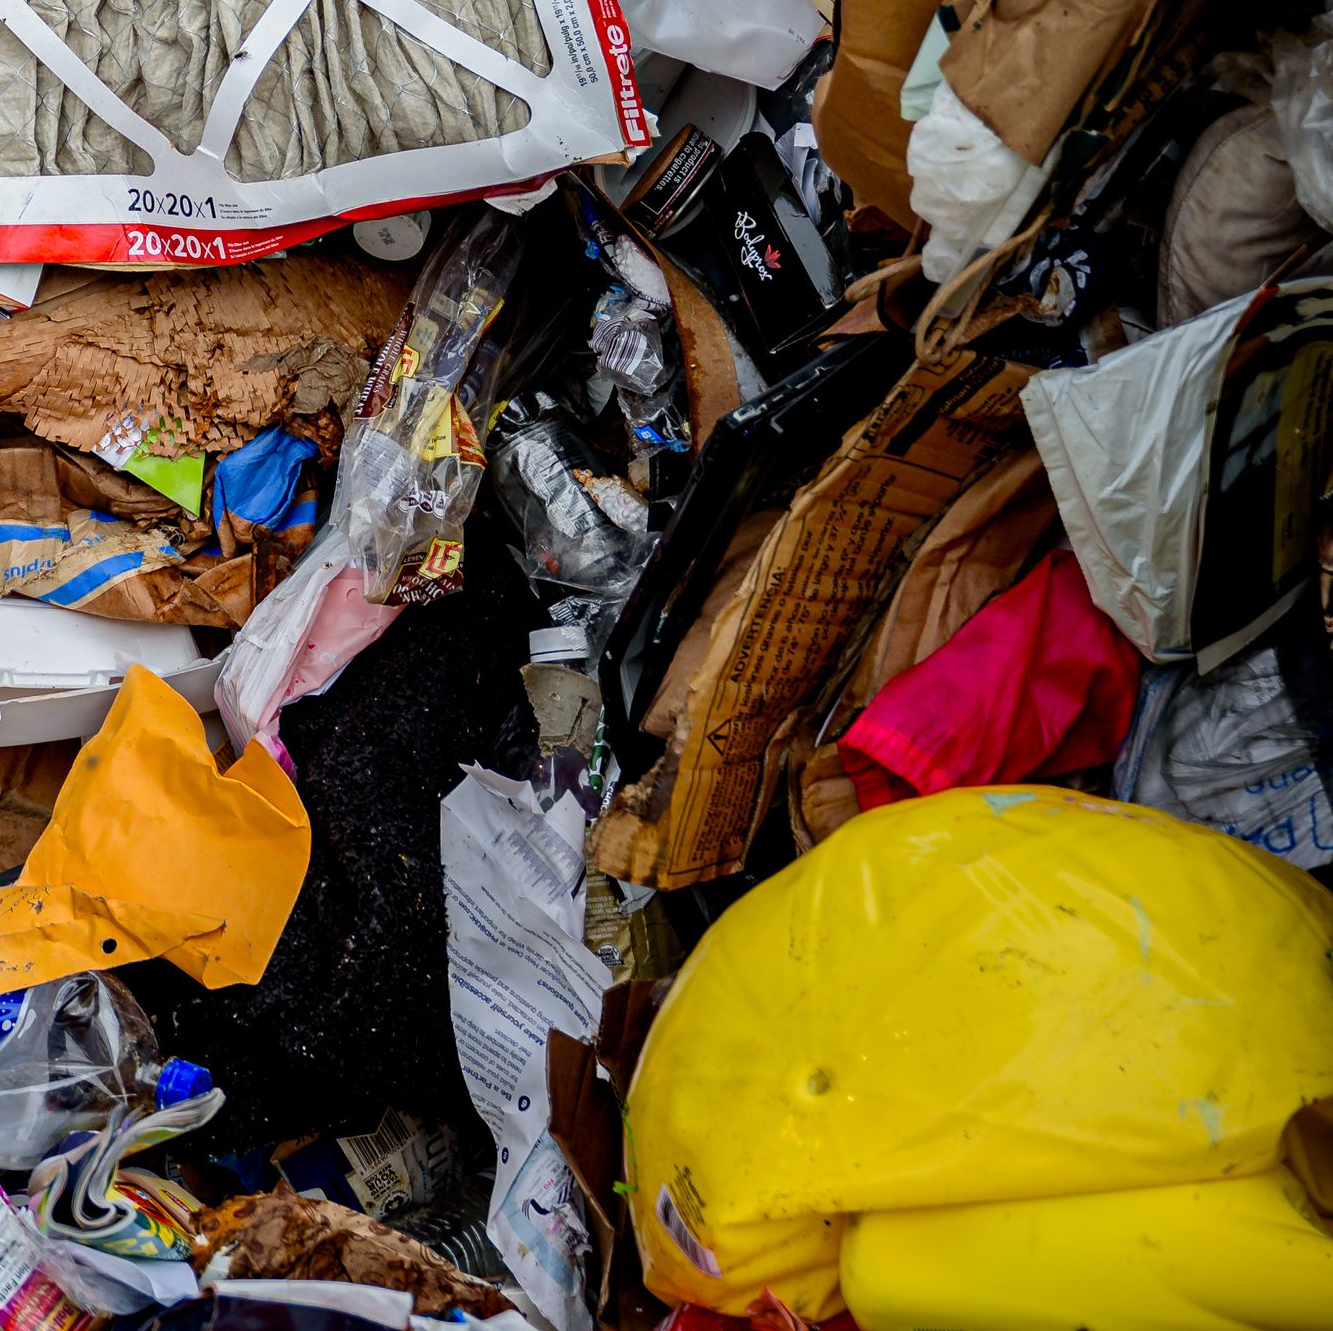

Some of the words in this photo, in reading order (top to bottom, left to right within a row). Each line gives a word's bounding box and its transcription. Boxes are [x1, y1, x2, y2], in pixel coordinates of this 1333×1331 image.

[607, 24, 645, 142] Filtrete
[652, 151, 689, 194] cigarettes.
[676, 146, 704, 177] product
[128, 188, 217, 219] 20x20x1
[128, 230, 226, 260] 20x20x1
[373, 364, 392, 394] GRAINS
[451, 972, 493, 1005] accessible
[536, 979, 573, 1011] questions?
[491, 1001, 523, 1030] yourself
[573, 1007, 589, 1028] Have
[523, 1028, 546, 1046] Make
[461, 1065, 496, 1090] Partner
[500, 1089, 512, 1102] Be
